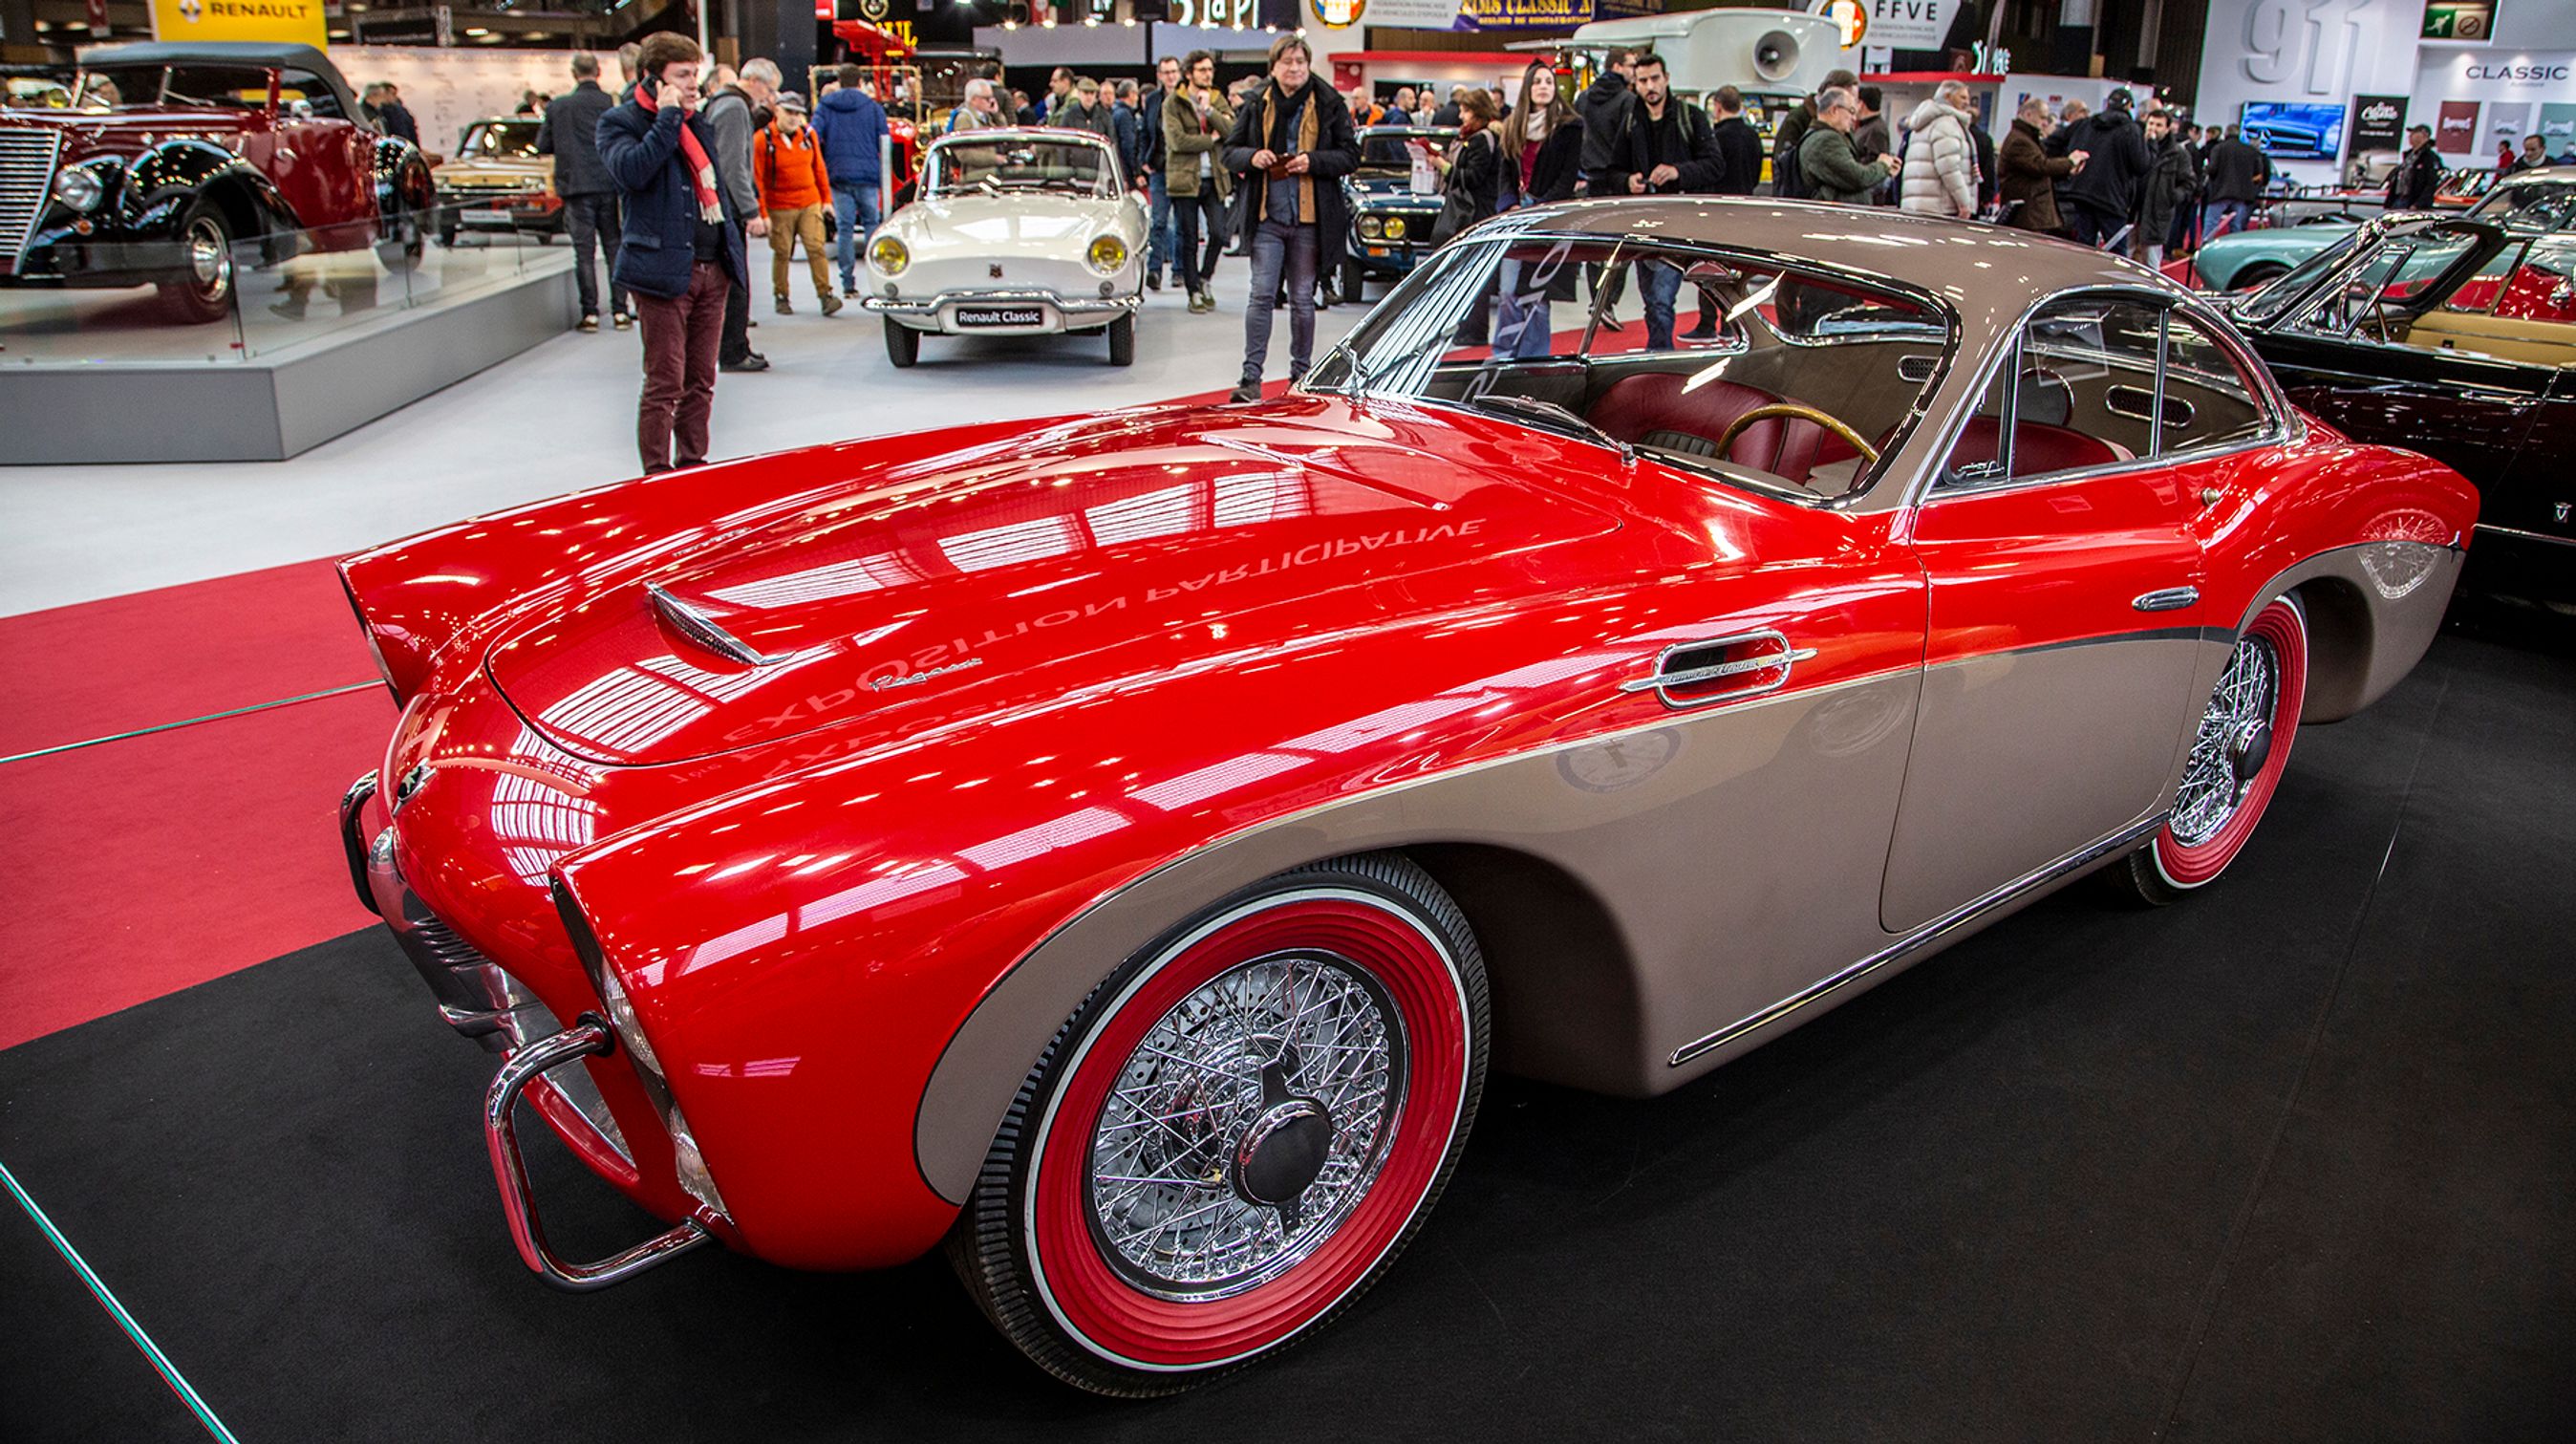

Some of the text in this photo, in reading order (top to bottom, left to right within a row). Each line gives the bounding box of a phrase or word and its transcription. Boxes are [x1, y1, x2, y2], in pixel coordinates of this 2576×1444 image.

[209, 2, 308, 19] RENAULT
[1875, 0, 1937, 21] FFVE
[2240, 0, 2382, 96] 911
[2465, 66, 2569, 80] CLASSIC
[958, 311, 1040, 323] Renault Classic
